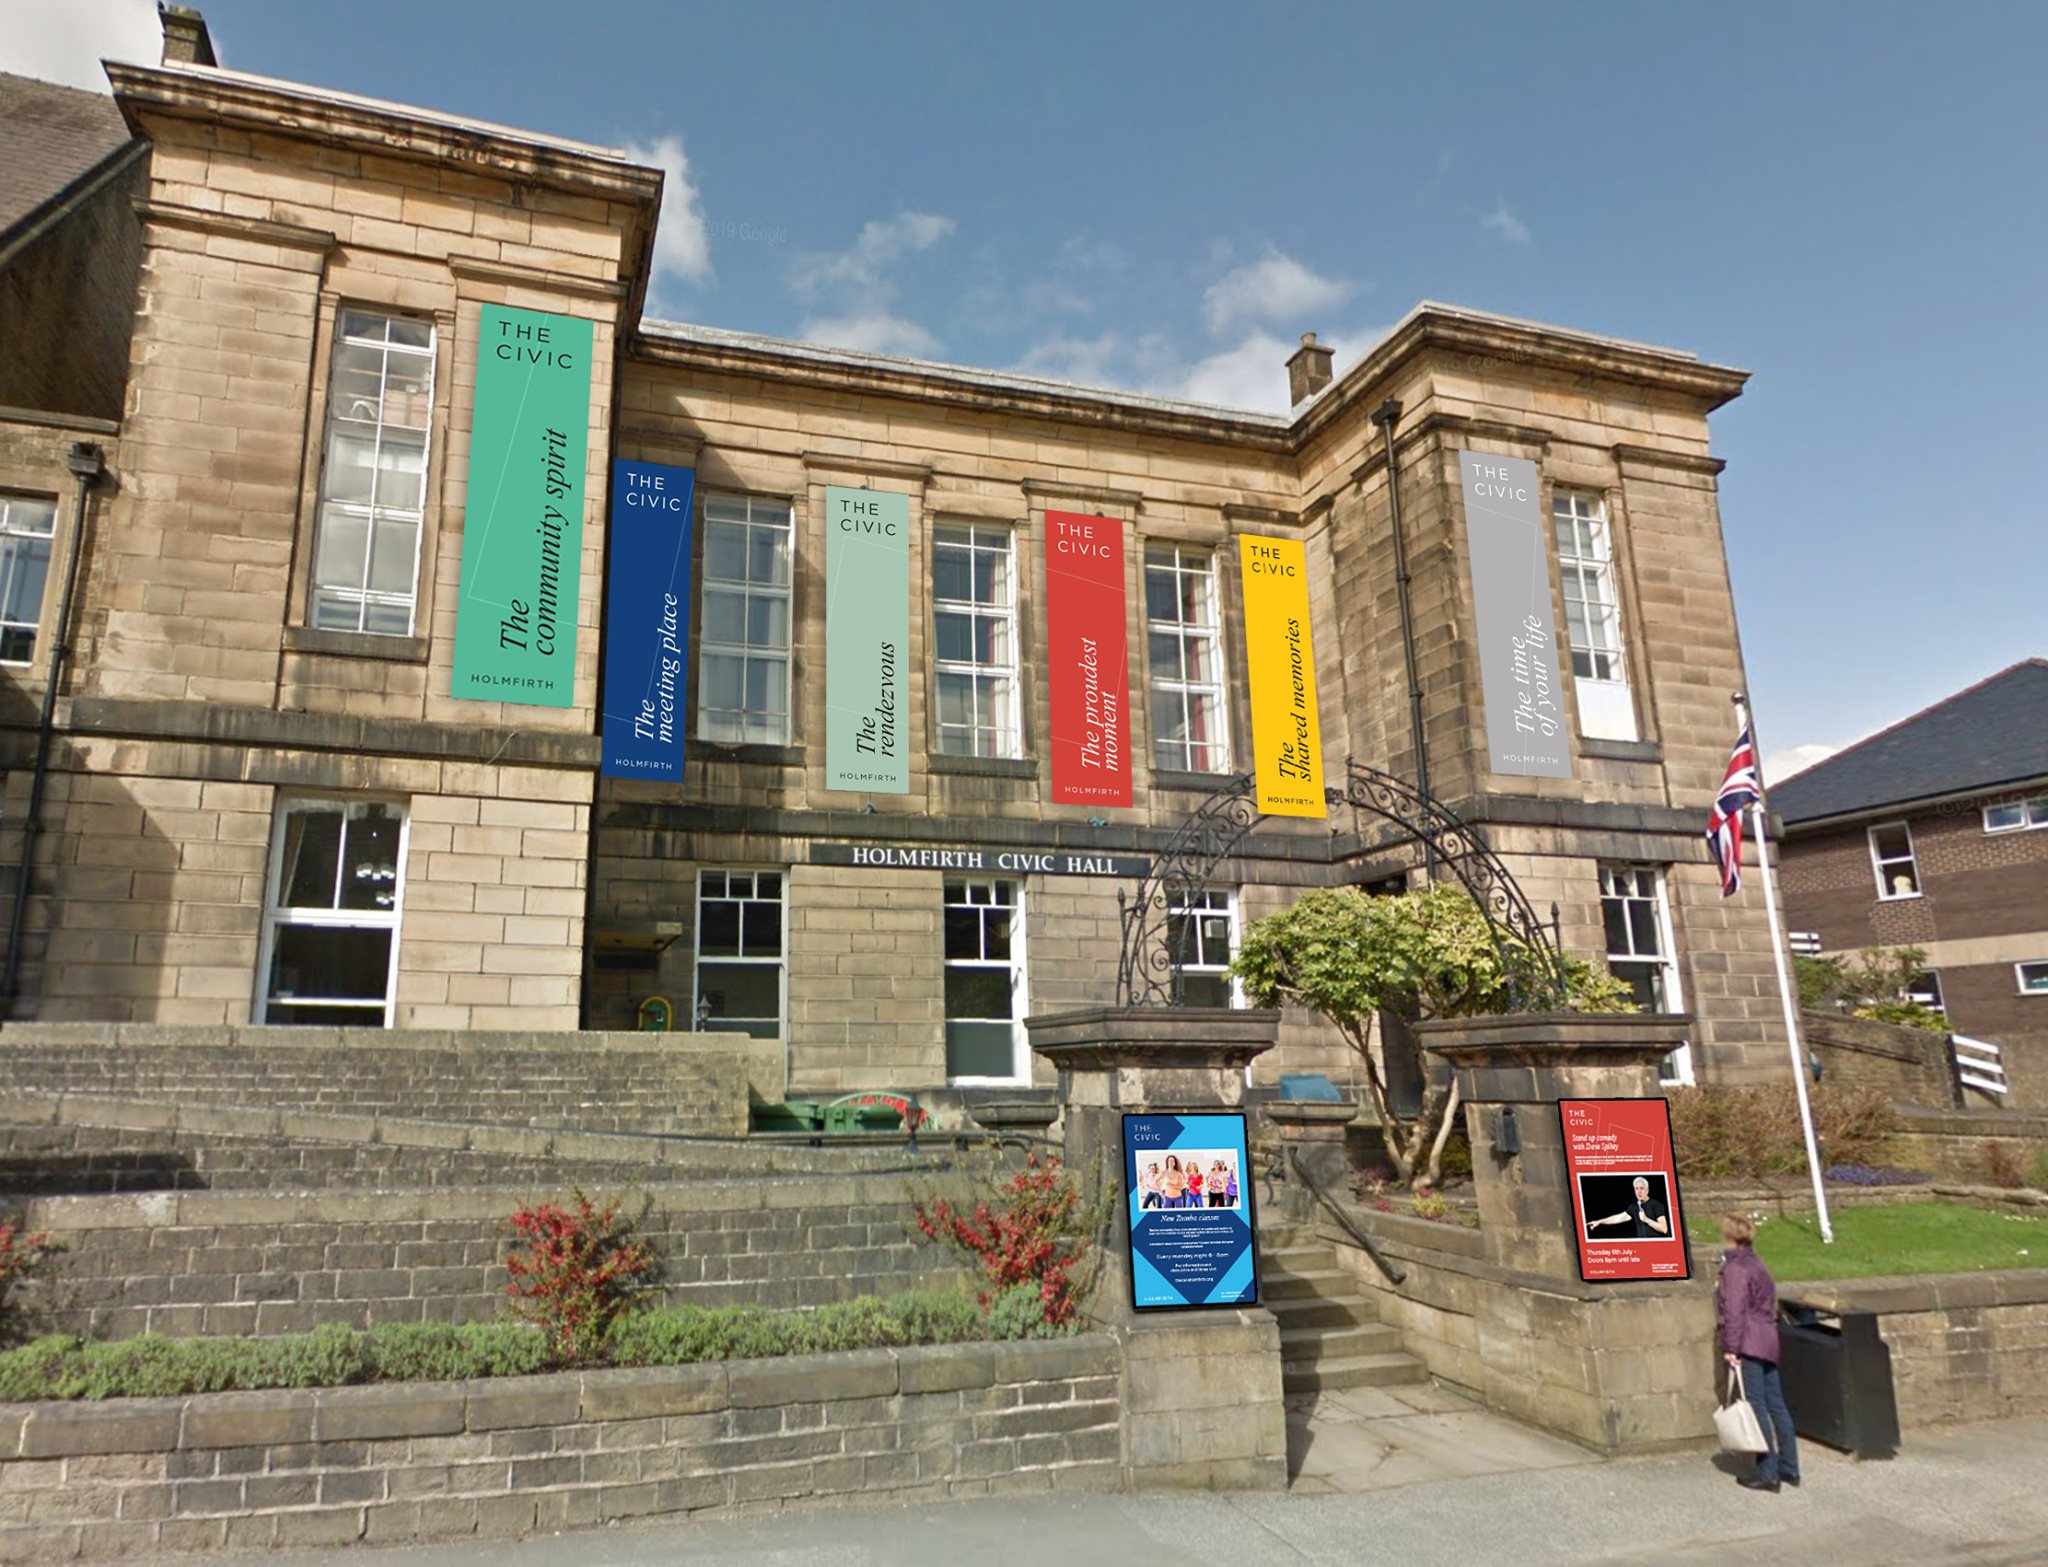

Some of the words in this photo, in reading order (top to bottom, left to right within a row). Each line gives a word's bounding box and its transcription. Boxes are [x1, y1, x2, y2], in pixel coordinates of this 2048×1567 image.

[498, 321, 551, 344] THE
[496, 342, 573, 369] CIVIC
[542, 428, 572, 499] spirit
[1471, 463, 1509, 482] THE
[627, 473, 665, 491] THE
[1474, 482, 1527, 502] CIVIC
[626, 491, 681, 512] CIVIC
[840, 500, 879, 516] THE
[840, 518, 896, 536] CIVIC
[1057, 523, 1094, 539] THE
[1057, 541, 1111, 558] CIVIC
[1250, 545, 1280, 560] THE
[536, 505, 569, 656] community
[1251, 561, 1296, 577] CIVIC
[500, 599, 530, 651] The
[657, 593, 681, 654] place
[1523, 615, 1548, 648] life
[1285, 618, 1305, 709] memories
[1511, 636, 1530, 684] time
[471, 674, 554, 690] HOLMFIRTH
[1078, 637, 1104, 728] proudest
[1533, 655, 1556, 711] your
[656, 656, 681, 744] meeting
[875, 642, 895, 757] rendezvous
[1513, 691, 1535, 734] The
[635, 699, 655, 741] The
[1101, 691, 1118, 771] moment
[1532, 708, 1558, 737] of
[856, 716, 876, 755] The
[1081, 731, 1100, 767] The
[1290, 712, 1311, 782] shared
[615, 759, 672, 770] HOLMFIRTH
[1278, 742, 1296, 779] The
[1503, 753, 1559, 765] HOLMFIRTH
[839, 772, 897, 782] HOLMFIRTH
[1064, 786, 1120, 796] HOLMFIRTH
[1267, 796, 1315, 805] HOLMFIRTH
[852, 847, 982, 868] HOLMFIRTH
[998, 853, 1055, 872] CIVIC
[1067, 857, 1117, 874] HALL
[1134, 1133, 1161, 1141] CIVIC
